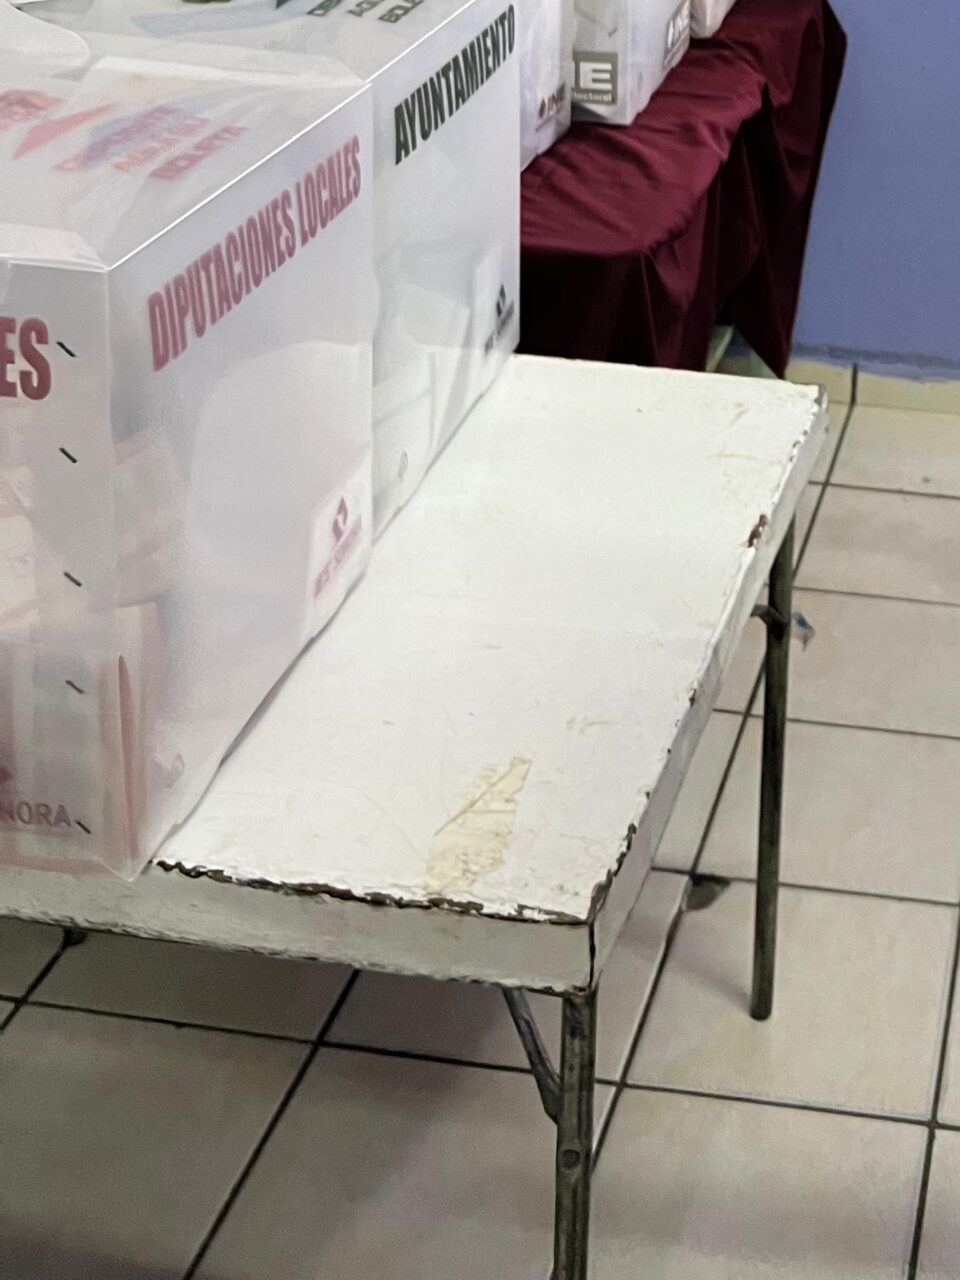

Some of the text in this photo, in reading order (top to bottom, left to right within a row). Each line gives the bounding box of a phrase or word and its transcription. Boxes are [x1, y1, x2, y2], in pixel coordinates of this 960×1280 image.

[394, 4, 516, 166] AYUNTAMIENTO
[148, 189, 297, 372] DIPUTACIONES
[295, 135, 361, 248] LOCALES
